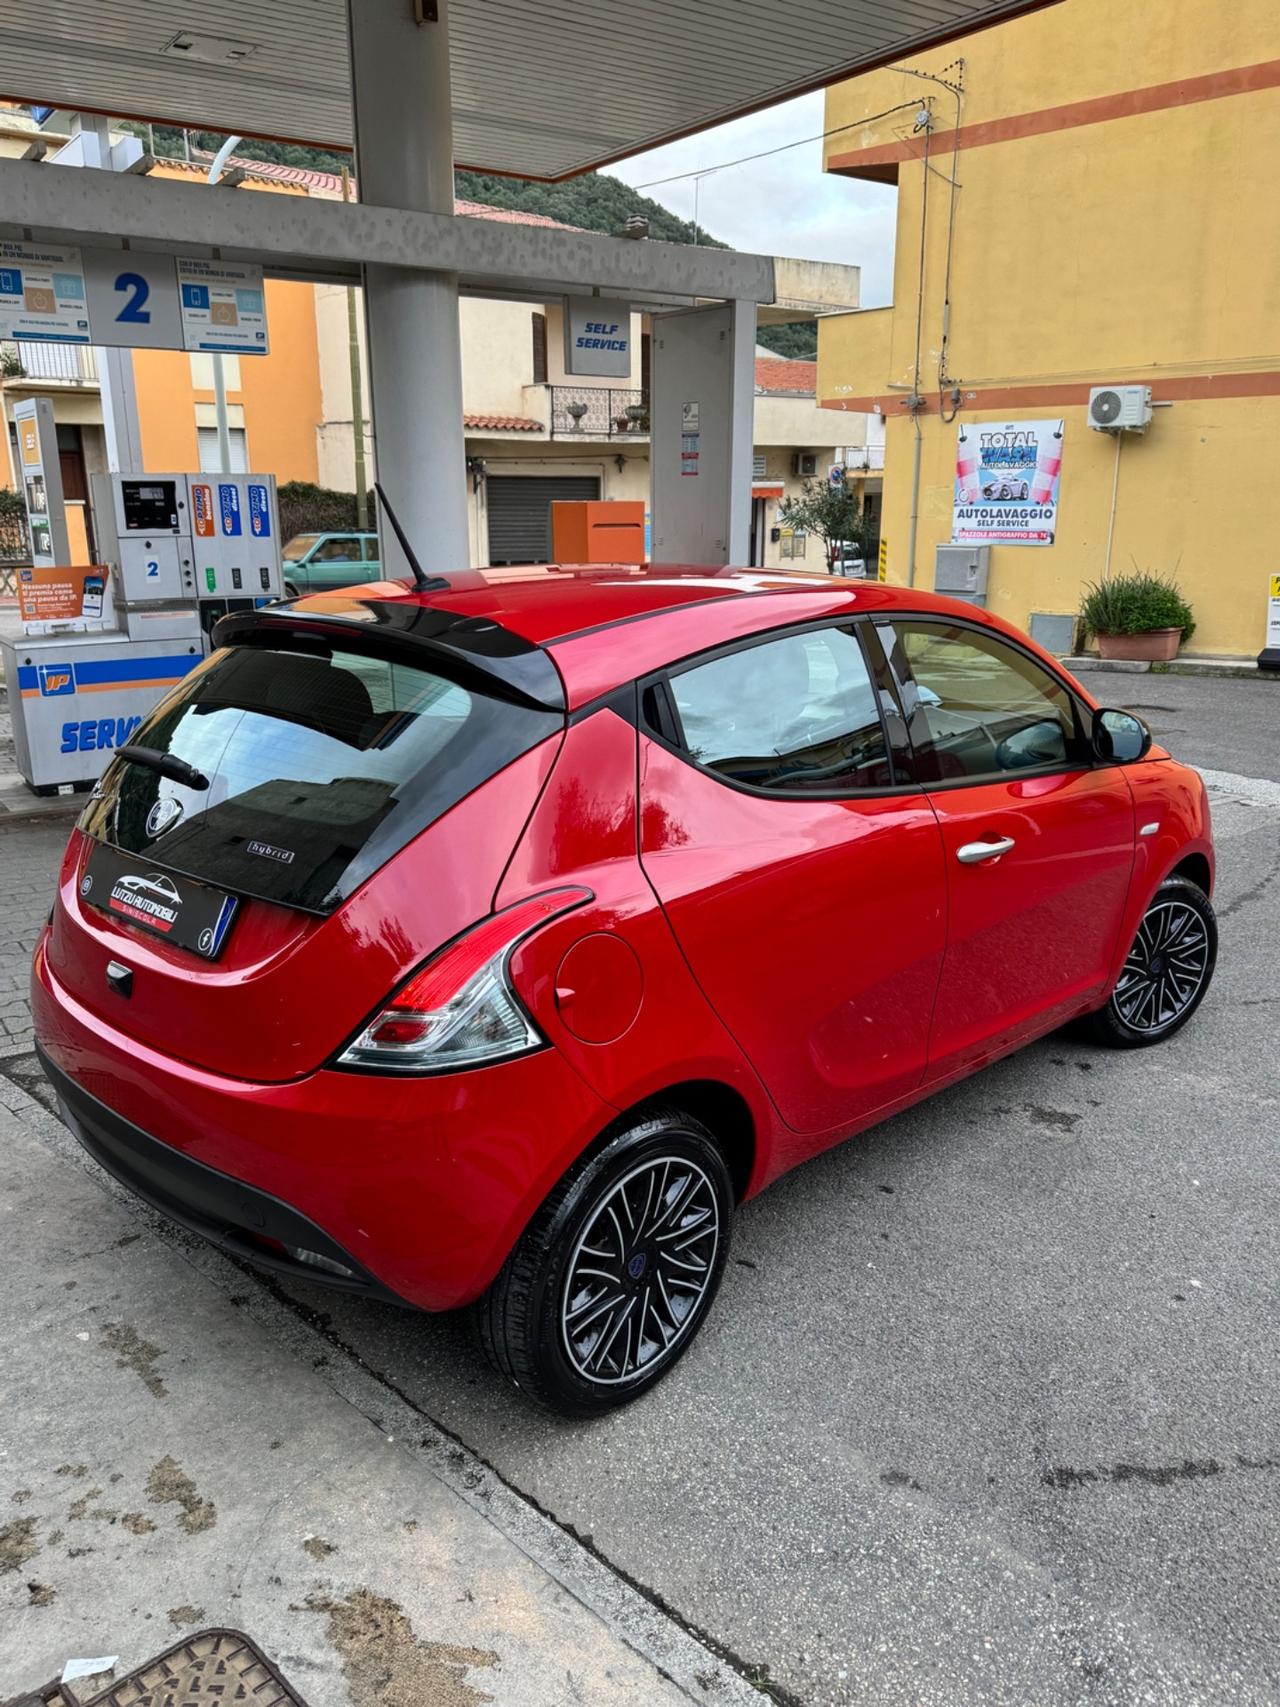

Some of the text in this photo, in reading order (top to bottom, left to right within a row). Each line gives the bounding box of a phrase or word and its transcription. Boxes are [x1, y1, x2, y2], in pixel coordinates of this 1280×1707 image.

[114, 272, 151, 324] 2
[584, 322, 619, 335] SELF
[575, 337, 627, 352] SERVICE
[980, 431, 1039, 448] TOTAL
[980, 446, 1038, 463] WASH
[230, 487, 238, 511] diesel
[259, 488, 267, 512] diesel
[957, 508, 1054, 519] AUTOLAVAGGIO
[147, 561, 158, 576] 2
[51, 582, 72, 591] pausa
[38, 595, 58, 604] pausa
[46, 674, 70, 691] IP
[252, 843, 289, 860] hybrid
[110, 886, 178, 923] LUTZU AUTOMOBILI
